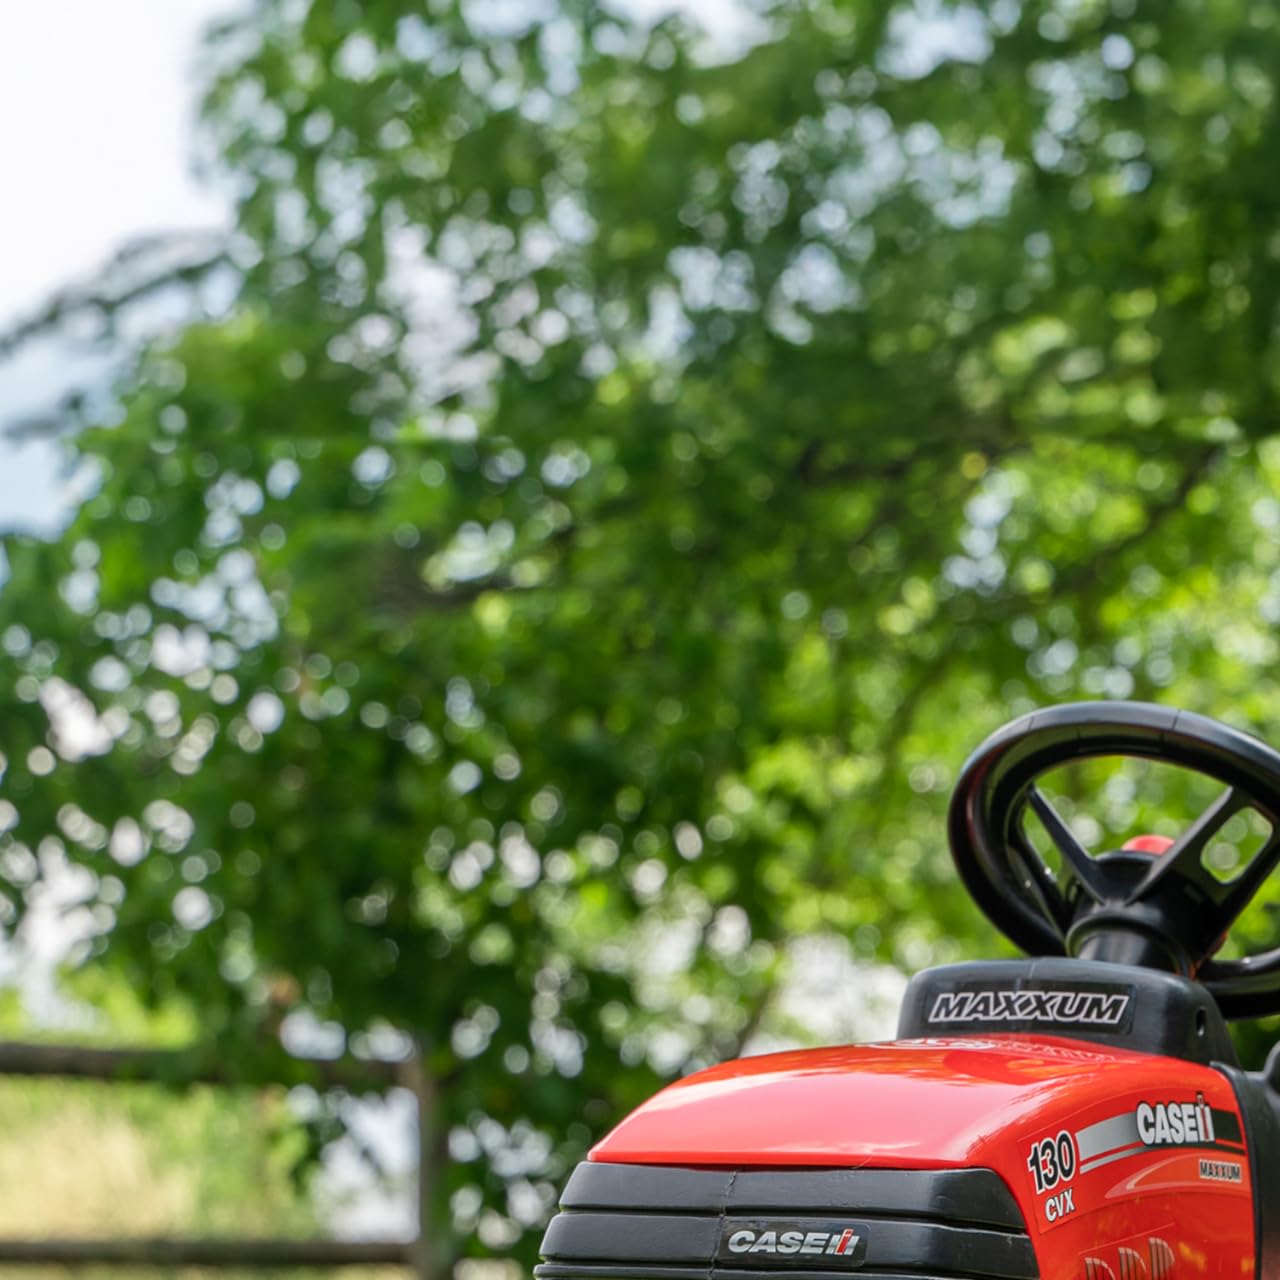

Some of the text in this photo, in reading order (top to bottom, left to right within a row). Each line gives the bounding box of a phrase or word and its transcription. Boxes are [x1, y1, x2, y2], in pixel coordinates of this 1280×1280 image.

[928, 990, 1129, 1024] MAXXUM
[1027, 1129, 1075, 1195] 130
[1199, 1158, 1242, 1183] MAXXUM
[1045, 1187, 1076, 1222] CVX
